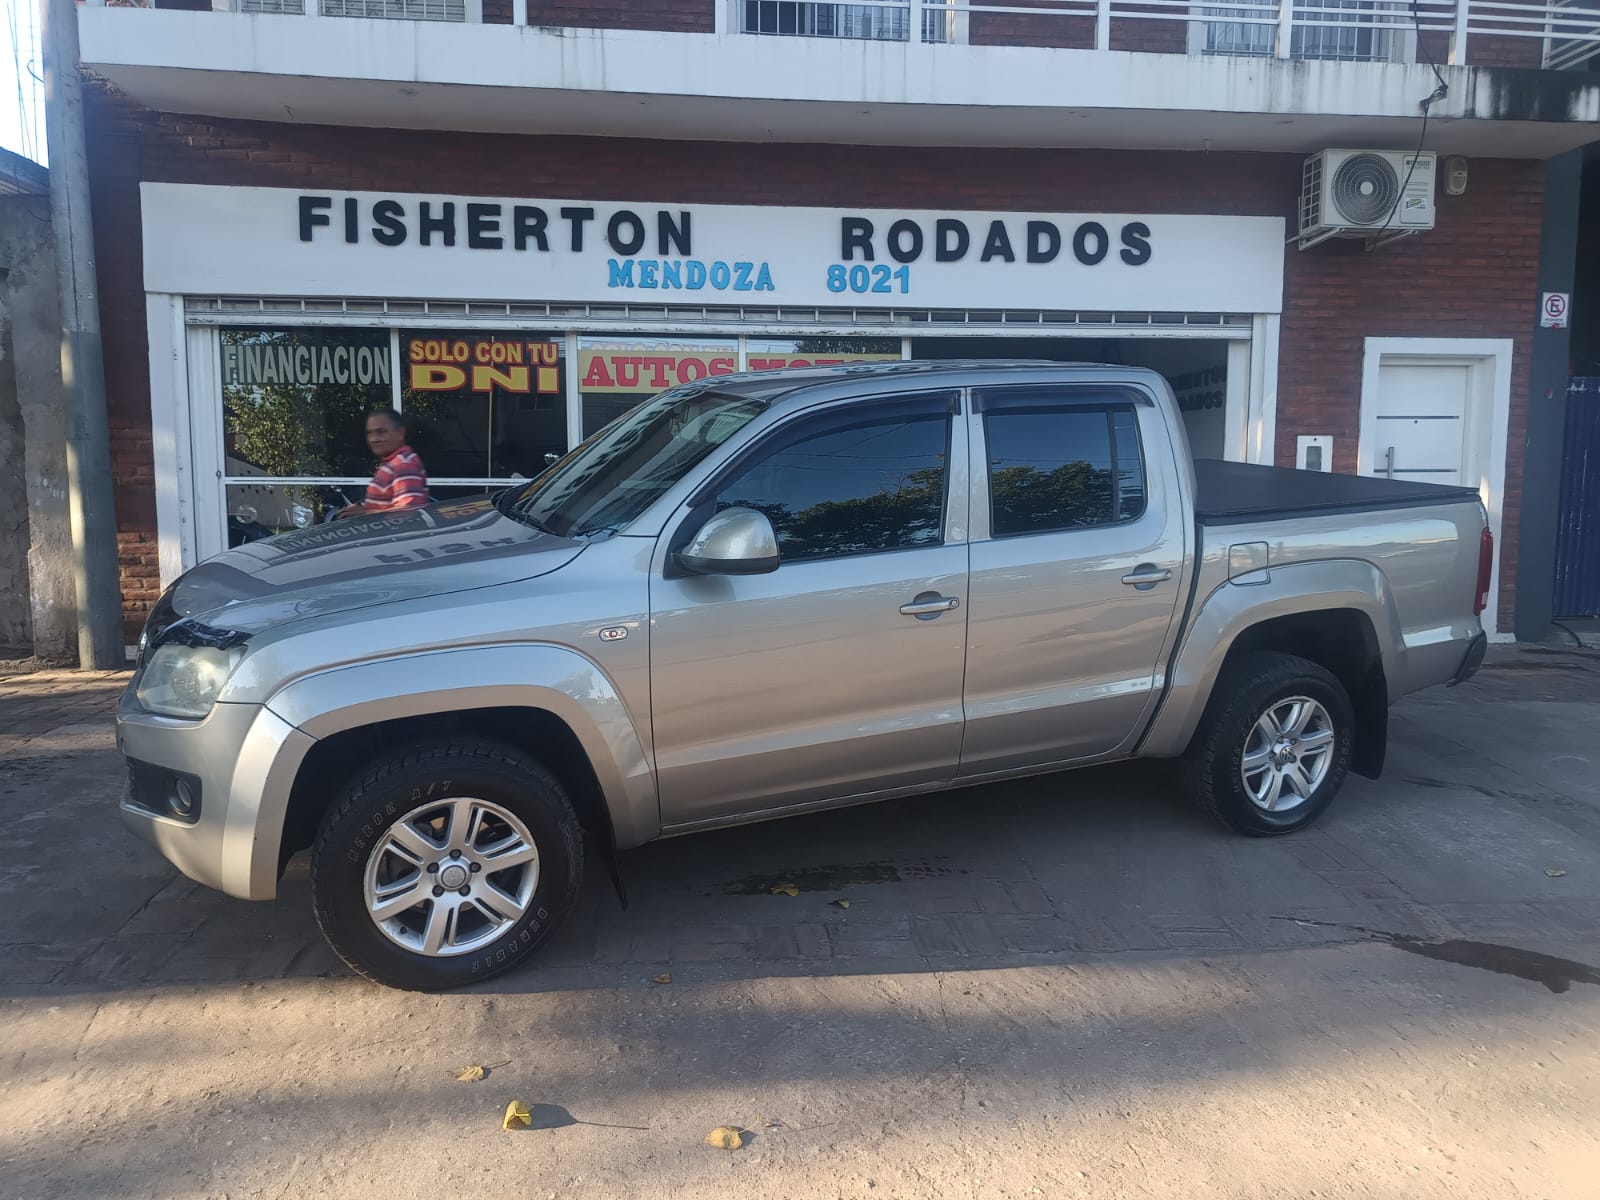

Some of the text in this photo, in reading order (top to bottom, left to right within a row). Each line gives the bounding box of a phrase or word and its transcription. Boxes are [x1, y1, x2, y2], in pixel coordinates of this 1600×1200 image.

[298, 195, 1152, 266] FISHERTON RODADOS
[607, 258, 911, 294] MENDOZA 8021
[223, 345, 391, 385] FINANCIACION
[409, 340, 559, 365] SOLO CON TU
[409, 363, 560, 394] DNI
